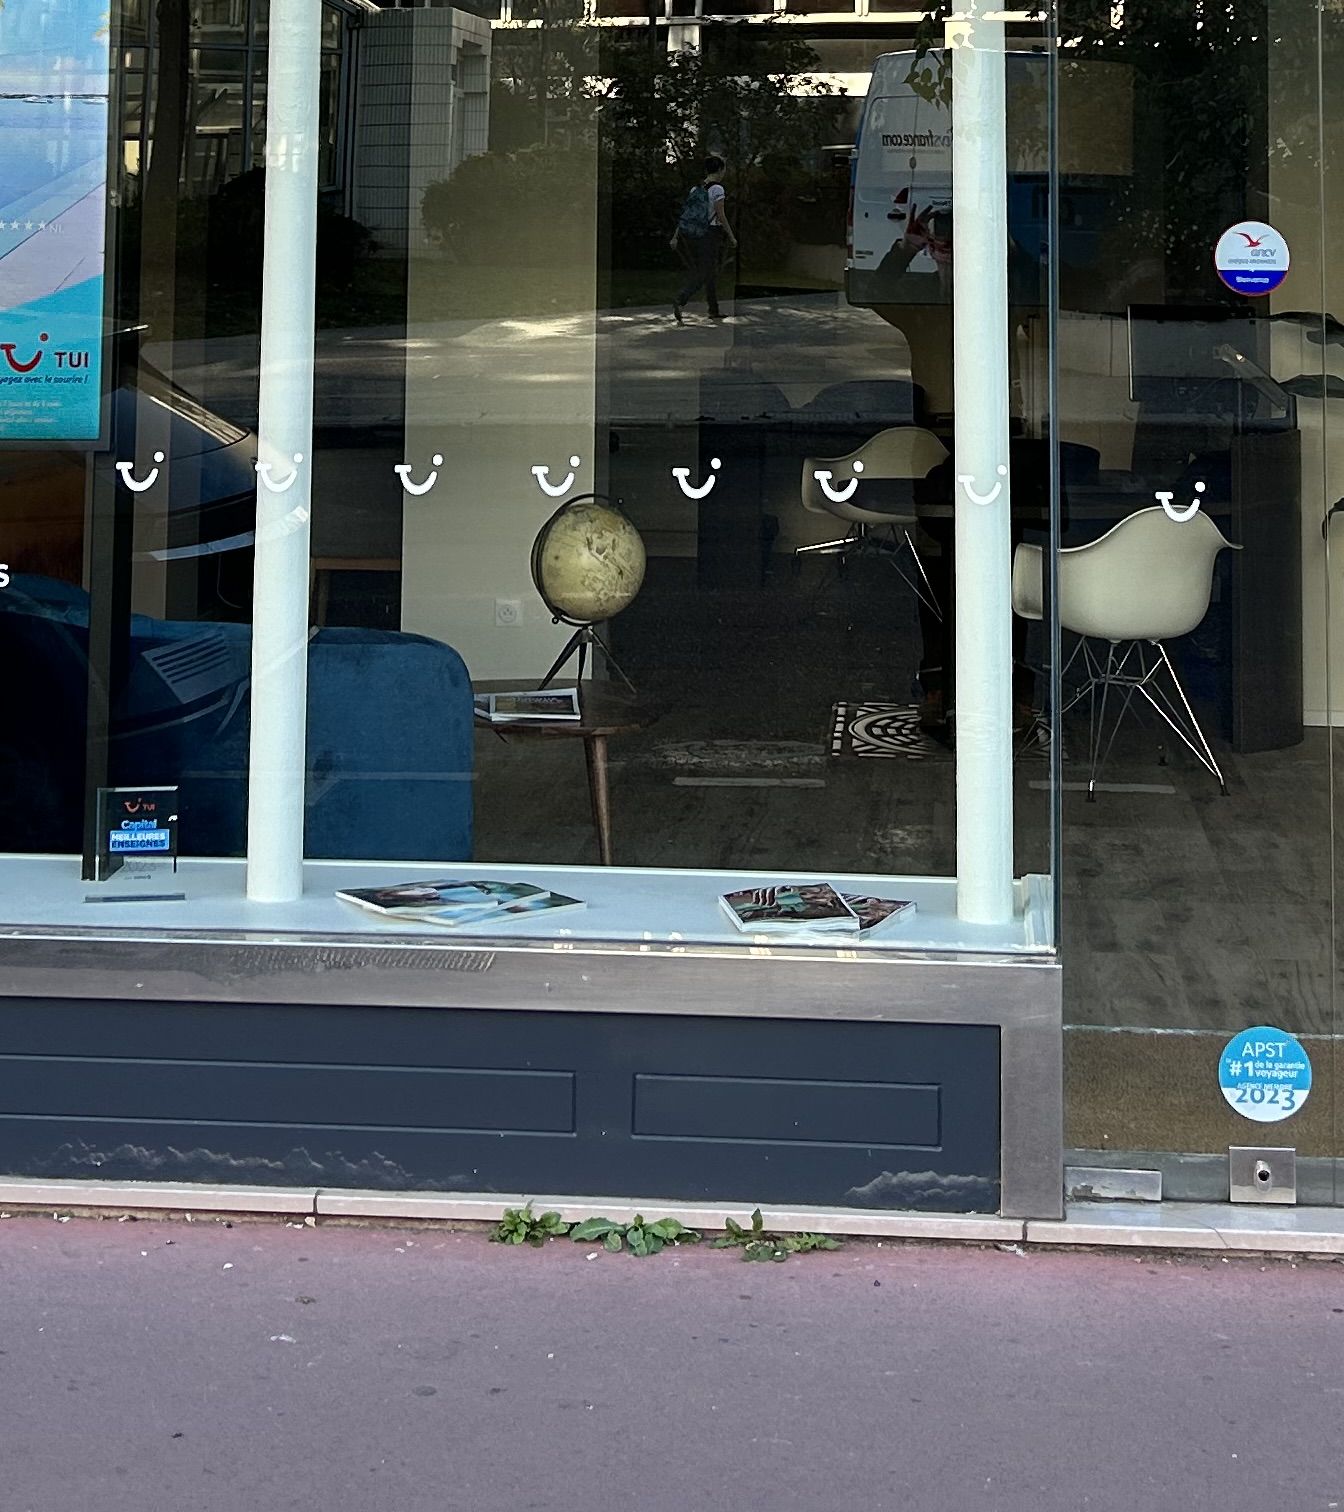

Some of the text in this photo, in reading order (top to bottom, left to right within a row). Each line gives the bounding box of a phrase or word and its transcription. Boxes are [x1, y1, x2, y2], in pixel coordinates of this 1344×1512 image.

[53, 351, 90, 369] TUI
[1241, 1041, 1286, 1057] APST
[1229, 1060, 1253, 1076] #1
[1255, 1070, 1298, 1079] voyageur
[1235, 1088, 1297, 1111] 2023
